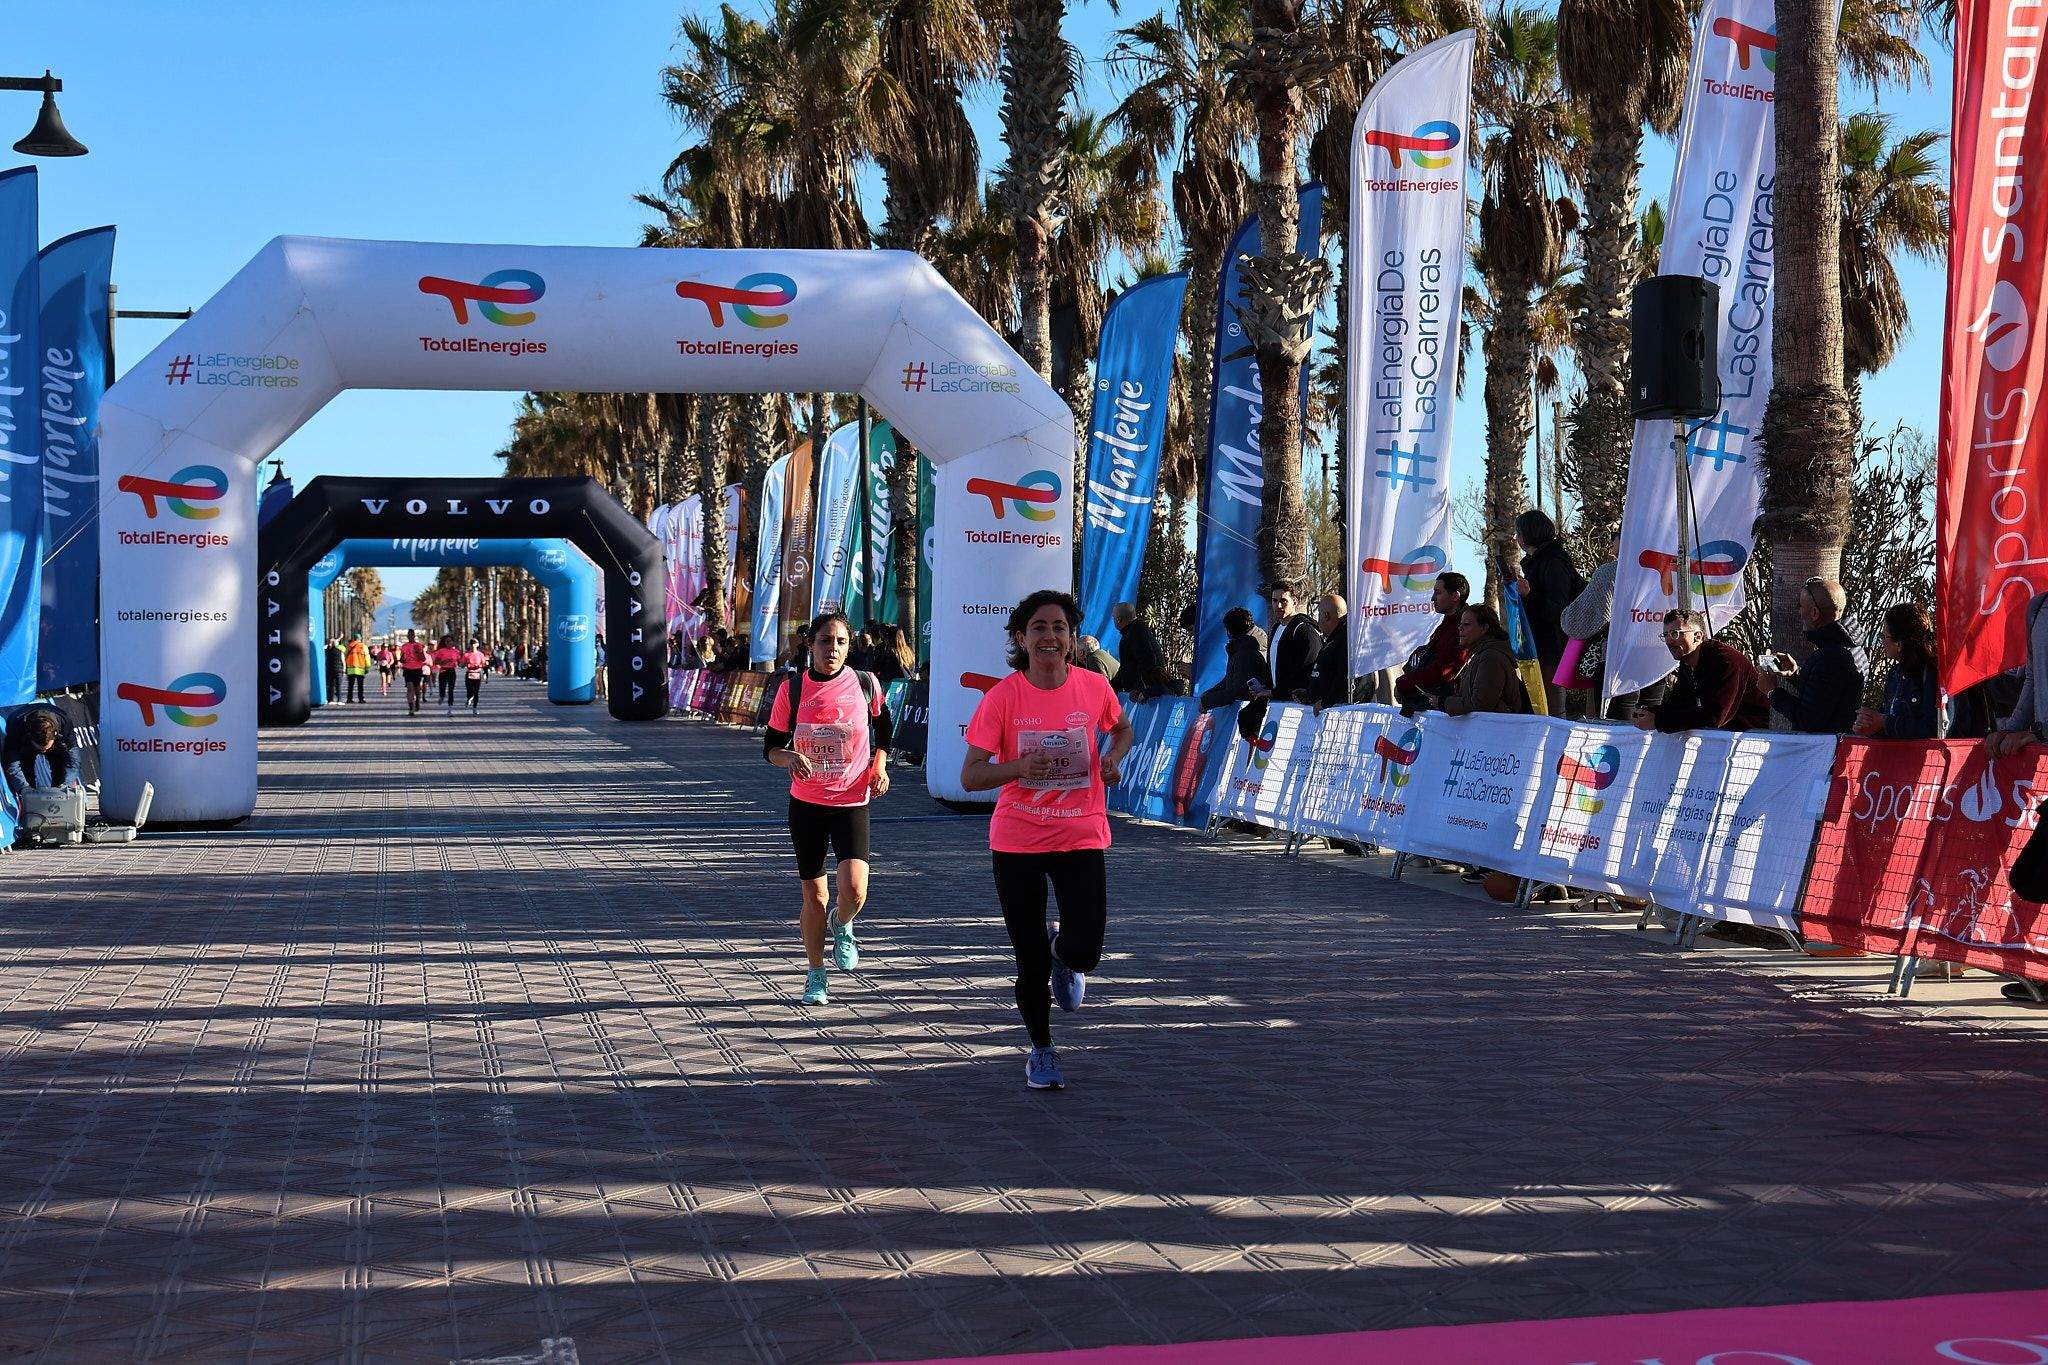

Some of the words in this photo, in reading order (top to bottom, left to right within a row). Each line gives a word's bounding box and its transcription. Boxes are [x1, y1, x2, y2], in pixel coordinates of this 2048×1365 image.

[1703, 78, 1775, 102] TotalEne
[1365, 179, 1459, 195] TotalEnergies
[419, 337, 547, 356] TotalEnergies
[677, 340, 799, 358] TotalEnergies
[1408, 247, 1442, 433] LasCarreras
[196, 370, 299, 388] LasCarreras
[930, 377, 1021, 394] LasCarreras
[1086, 380, 1151, 534] Marlene
[361, 499, 550, 515] VOLVO
[1974, 387, 2048, 617] Sports
[828, 498, 840, 541] Institutos
[118, 531, 229, 548] TotalEnergies
[965, 530, 1061, 548] TotalEnergies
[117, 609, 228, 624] totalenergies.es
[962, 603, 1014, 616] totalene
[267, 570, 282, 705] VOLVO
[628, 571, 643, 702] VOLVO
[1013, 717, 1042, 726] OYSHO
[116, 737, 227, 756] TotalEnergies
[1050, 757, 1070, 768] 16
[1457, 776, 1514, 806] LasCarreras
[1695, 788, 1703, 800] la
[1361, 794, 1406, 816] TotalEnergies
[1854, 771, 1959, 834] Sports
[1041, 807, 1051, 816] DE
[1051, 808, 1060, 818] LA
[1722, 812, 1764, 831] patrocina
[1446, 814, 1489, 831] totalenergies.es
[1540, 823, 1600, 851] TotalEnergies
[1665, 827, 1697, 842] carreras
